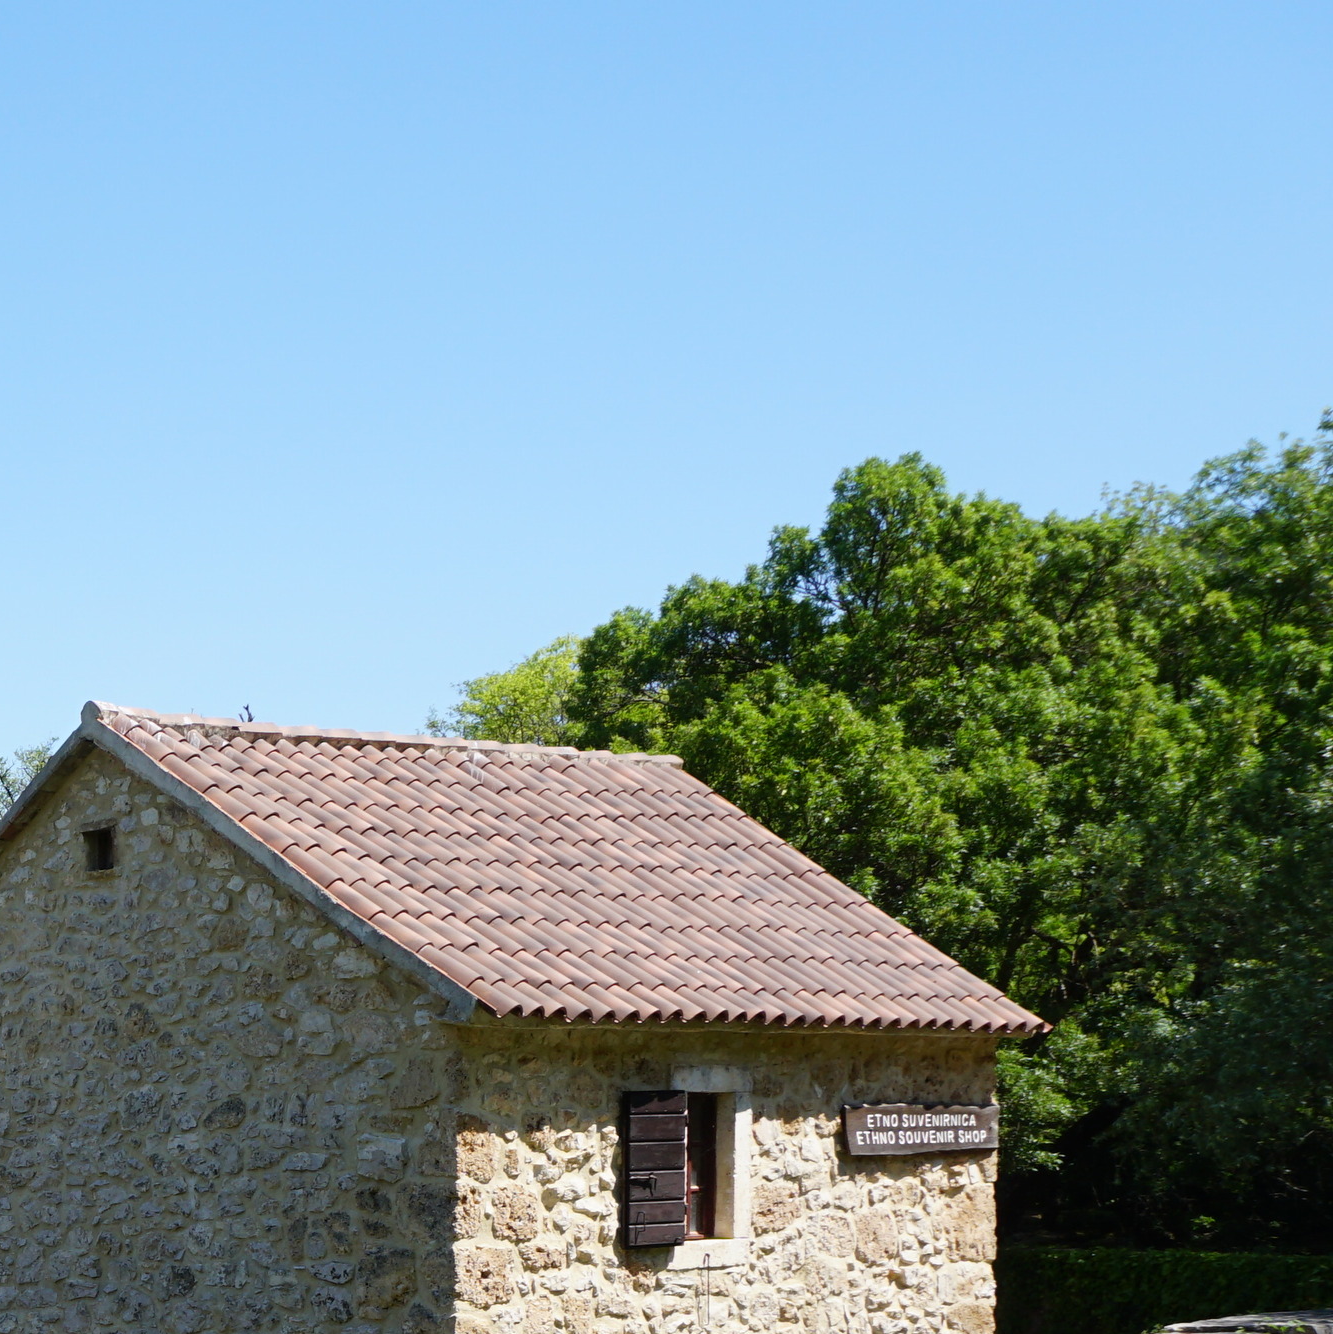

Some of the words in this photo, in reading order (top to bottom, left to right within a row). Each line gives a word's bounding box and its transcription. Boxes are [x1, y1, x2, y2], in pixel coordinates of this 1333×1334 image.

[867, 1113, 899, 1128] ETNO
[901, 1113, 977, 1128] SUVENIRNICA
[856, 1130, 896, 1145] ETHNO
[898, 1130, 955, 1144] SOUVENIR
[958, 1130, 987, 1143] SHOP
